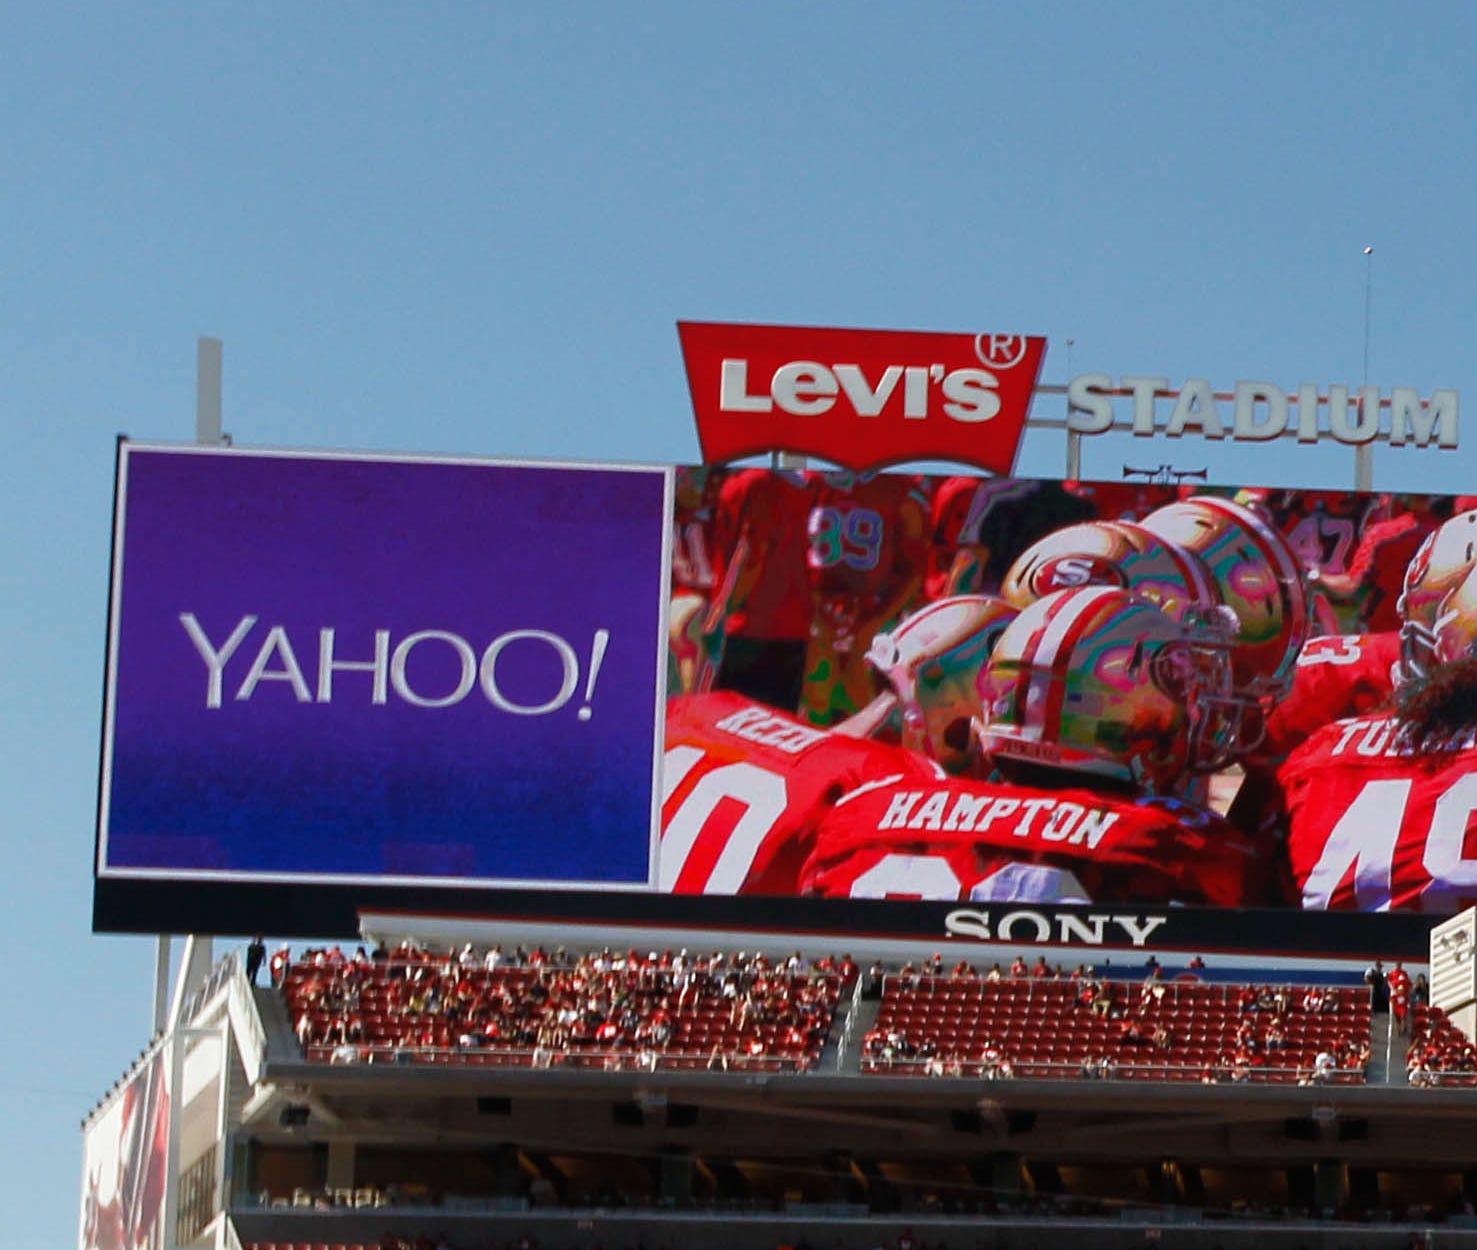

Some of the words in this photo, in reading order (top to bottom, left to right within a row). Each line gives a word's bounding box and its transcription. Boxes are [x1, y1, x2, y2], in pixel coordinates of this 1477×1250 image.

[1066, 372, 1461, 450] STADIUM
[179, 613, 609, 722] YAHOO!
[877, 790, 1120, 851] HAMPTON
[944, 908, 1168, 947] SONY
